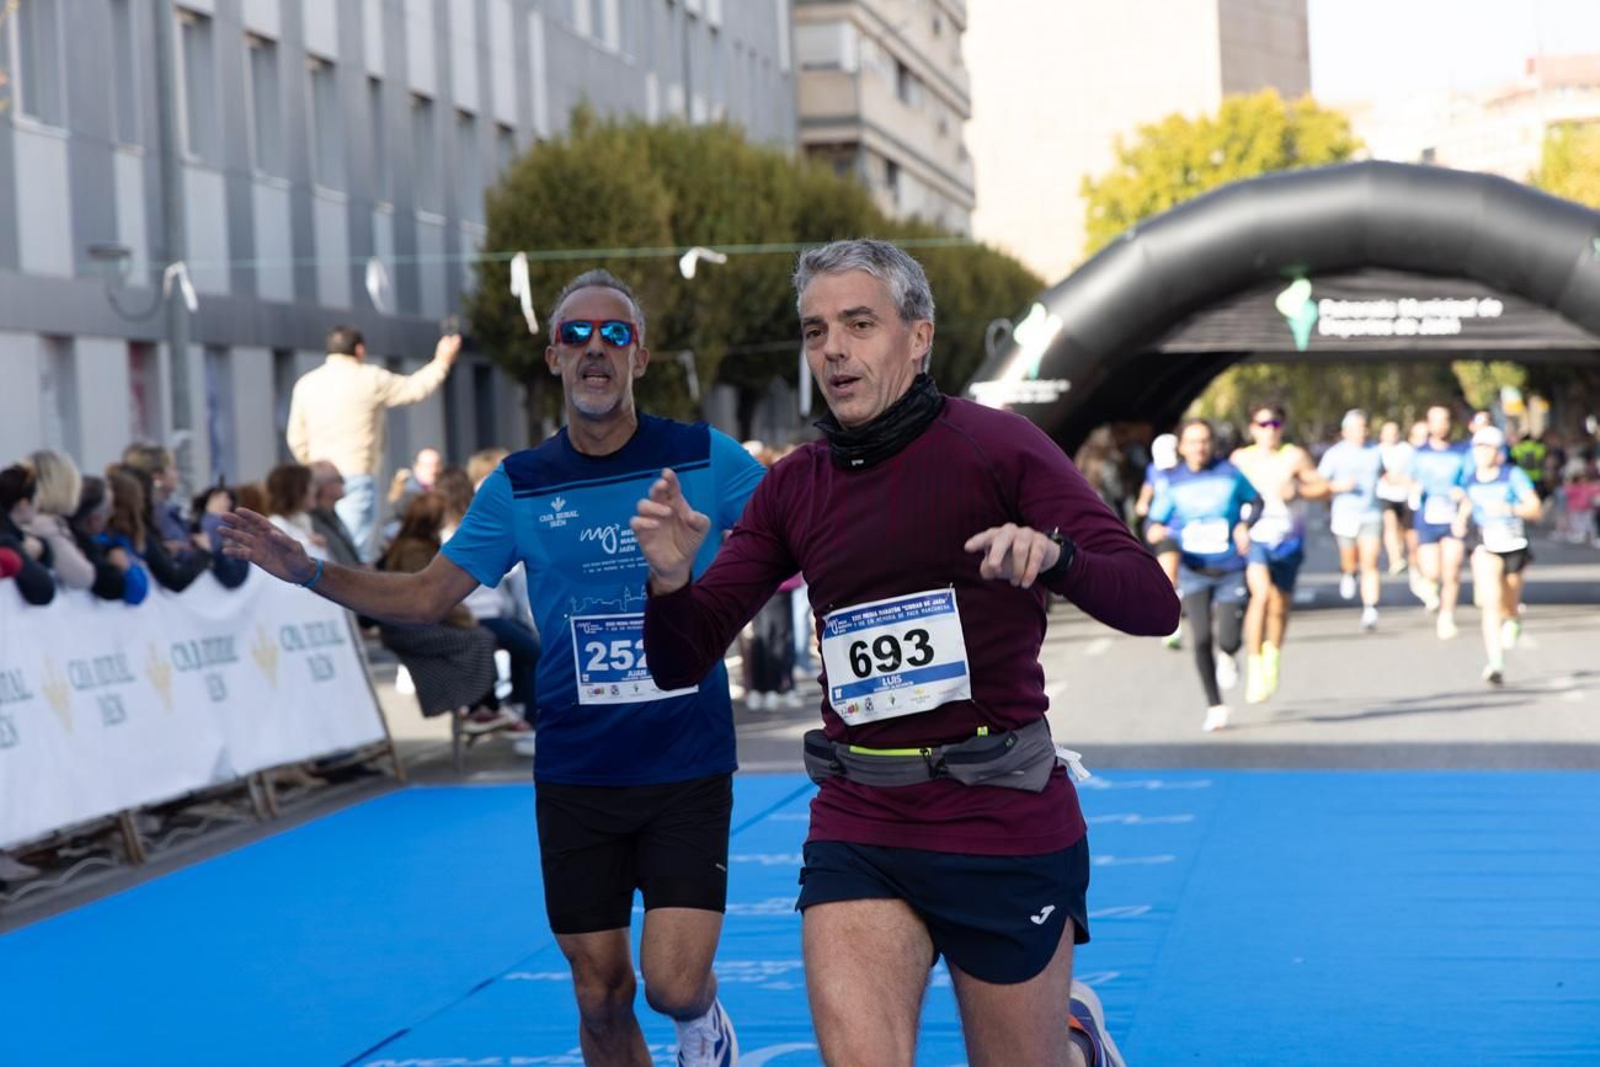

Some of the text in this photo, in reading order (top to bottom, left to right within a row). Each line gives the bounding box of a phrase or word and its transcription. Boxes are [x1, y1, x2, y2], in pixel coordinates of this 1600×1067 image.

[849, 628, 935, 679] 693
[627, 669, 647, 677] JUAN
[882, 674, 902, 686] LUIS
